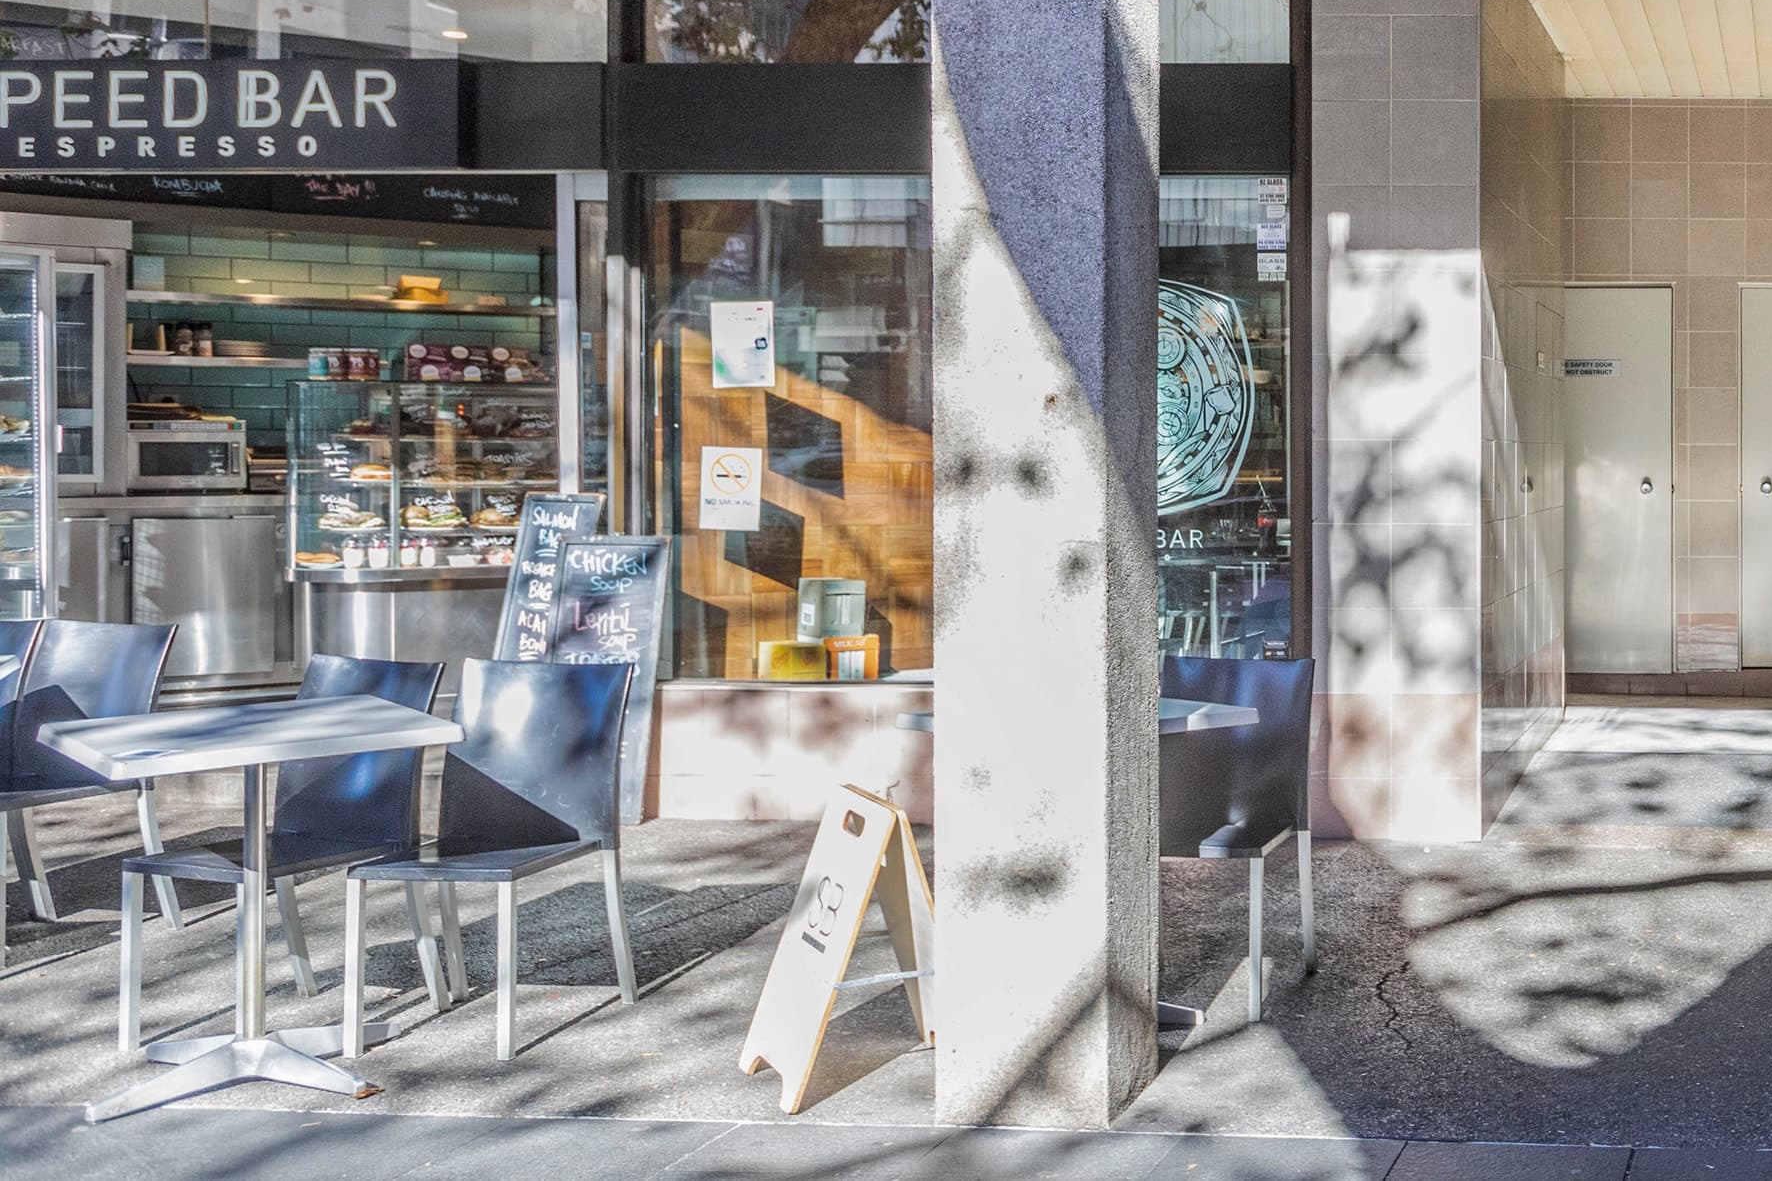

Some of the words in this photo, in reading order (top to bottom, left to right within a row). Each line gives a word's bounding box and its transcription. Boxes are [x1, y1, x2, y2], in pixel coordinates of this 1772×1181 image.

[0, 70, 208, 128] PEED
[236, 70, 397, 128] BAR
[18, 135, 318, 157] ESPRESSO
[532, 506, 579, 530] SALMON
[1157, 529, 1203, 549] BAR
[569, 549, 648, 576] CHICKEN
